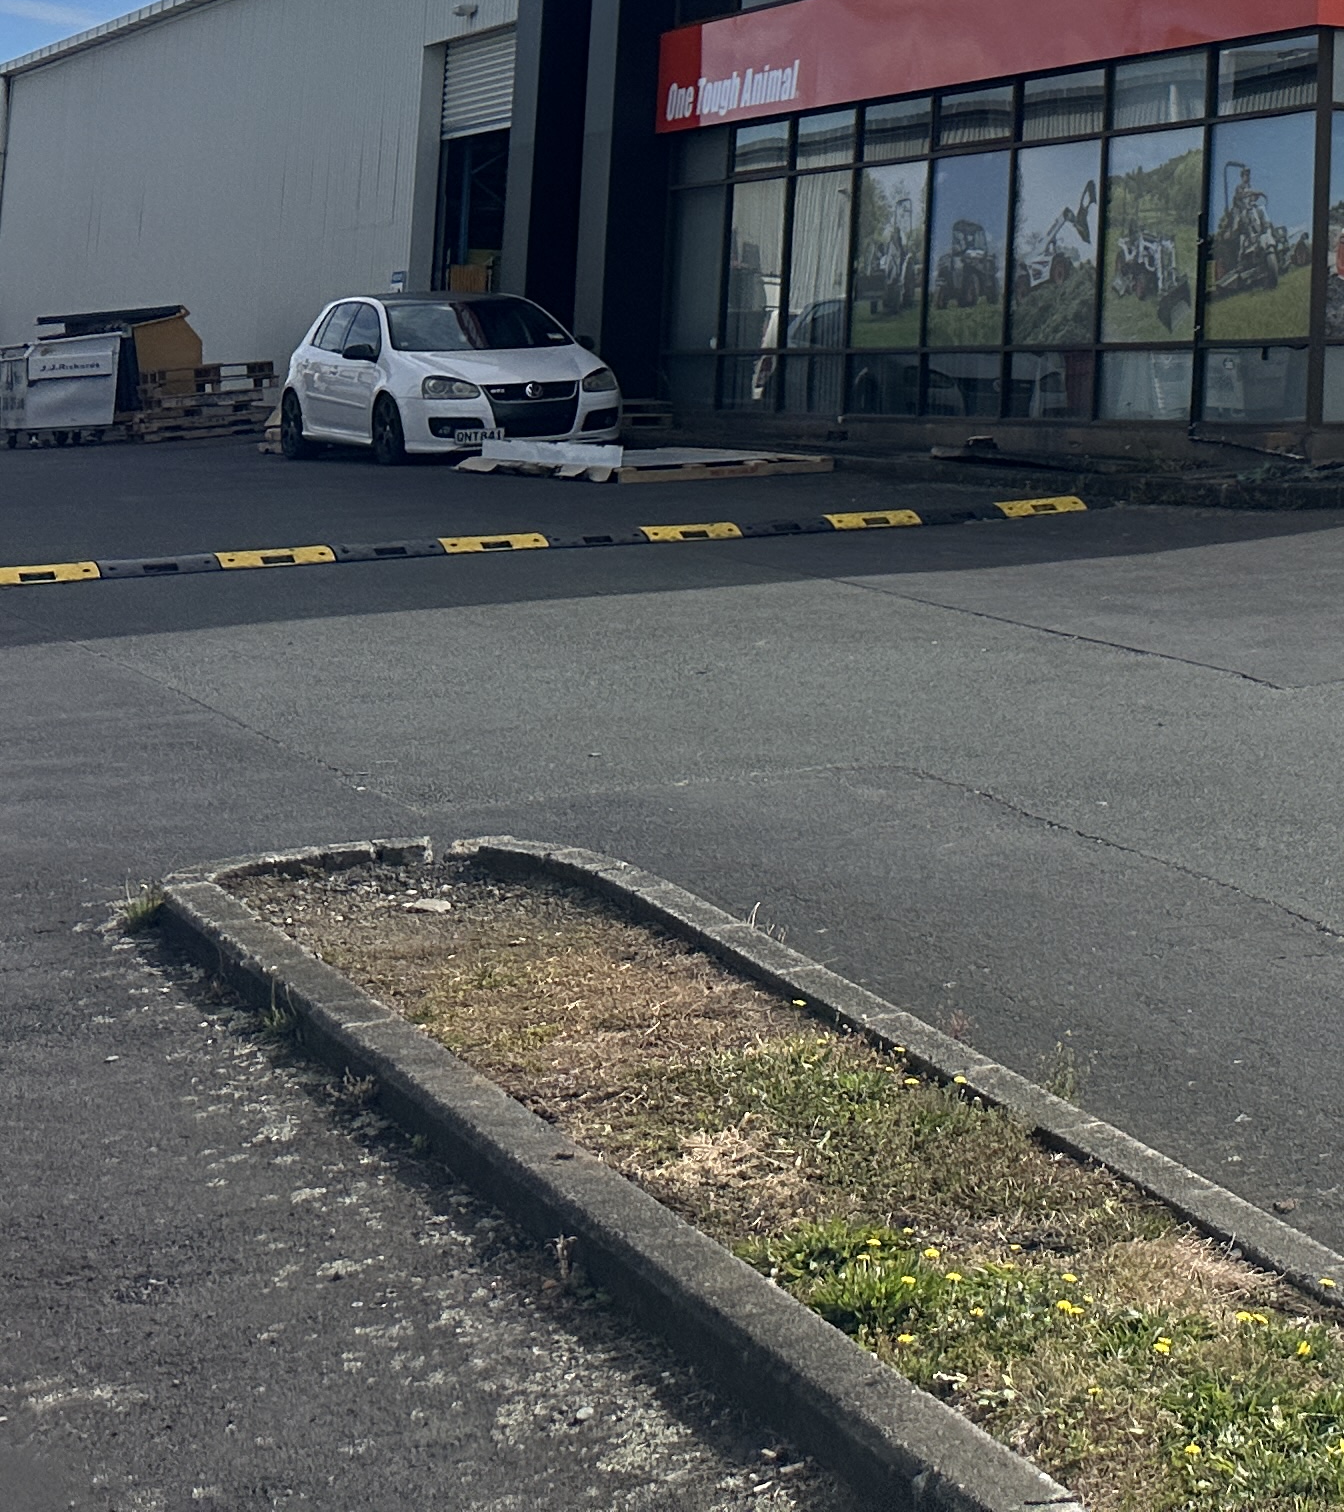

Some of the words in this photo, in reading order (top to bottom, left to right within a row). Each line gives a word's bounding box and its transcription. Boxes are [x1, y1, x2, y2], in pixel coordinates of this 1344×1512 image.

[666, 82, 695, 121] One
[696, 70, 741, 116] Tough
[740, 58, 800, 108] Animal
